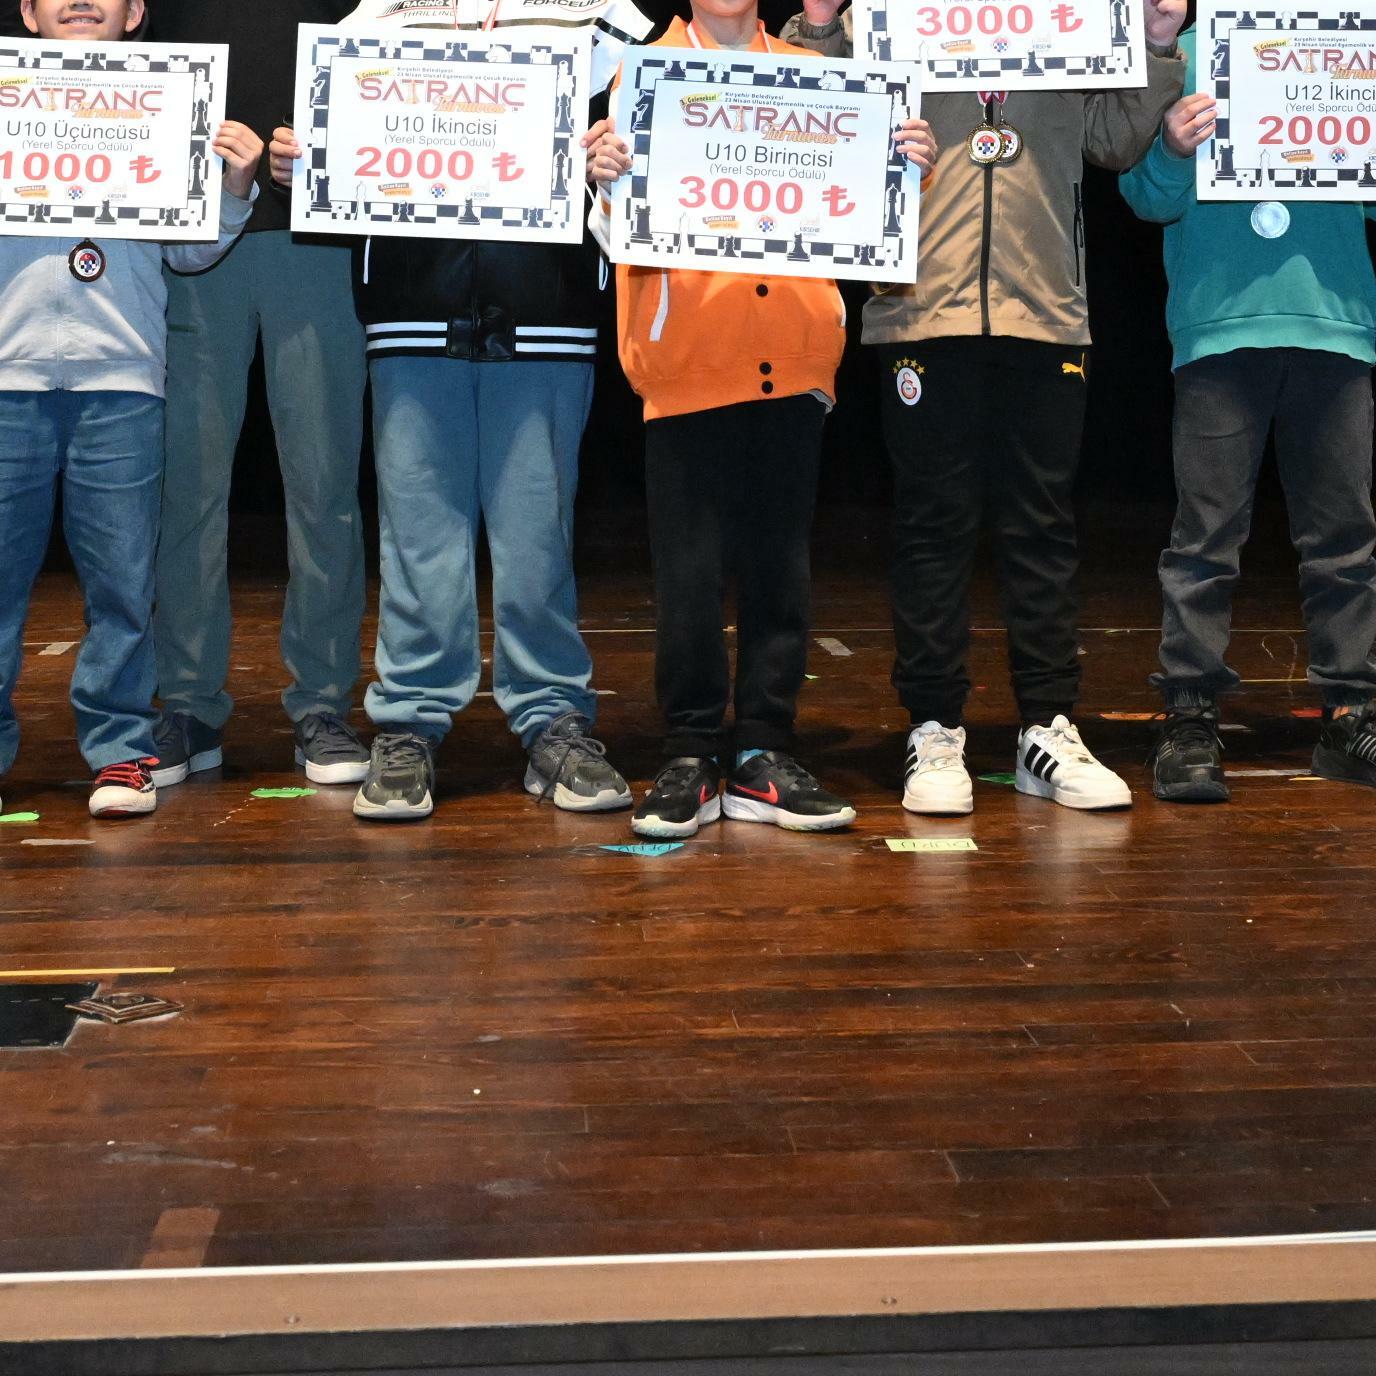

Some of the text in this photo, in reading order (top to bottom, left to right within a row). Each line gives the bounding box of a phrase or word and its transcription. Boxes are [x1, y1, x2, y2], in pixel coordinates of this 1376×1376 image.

[402, 0, 444, 8] RACING
[916, 4, 1034, 37] 3000
[359, 76, 526, 112] SATRANÇ
[1285, 84, 1323, 101] U12
[1285, 102, 1315, 114] (Yerel
[1317, 102, 1354, 114] Sporcu
[6, 119, 150, 144] U10 Üçüncüsü
[385, 113, 497, 136] U10 İkincisi
[684, 100, 859, 143] SATRANÇ
[1257, 115, 1371, 146] 2000
[56, 140, 94, 151] Sporcu
[384, 133, 415, 145] (Yerel
[418, 135, 456, 147] Sporcu
[354, 146, 474, 181] 2000
[705, 142, 833, 168] U10 Birincisi
[709, 163, 742, 175] (Yerel
[745, 165, 785, 178] Sporcu
[678, 175, 804, 215] 3000
